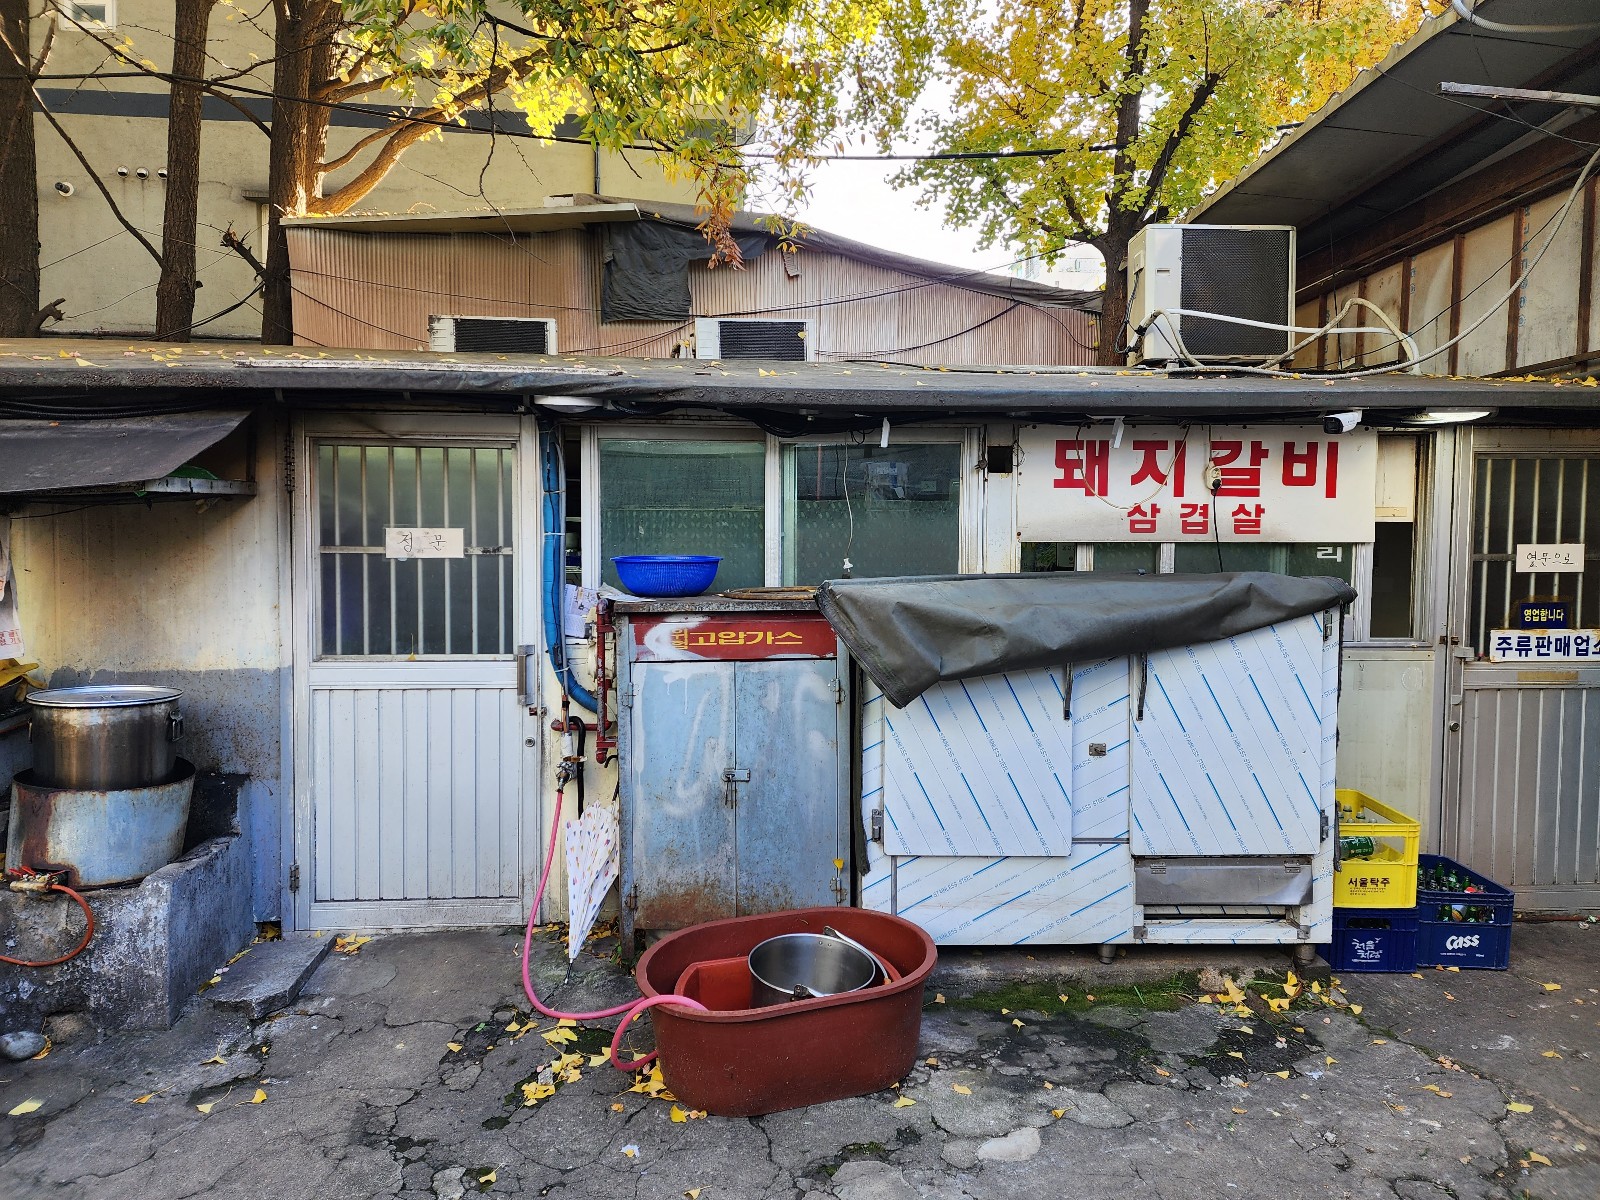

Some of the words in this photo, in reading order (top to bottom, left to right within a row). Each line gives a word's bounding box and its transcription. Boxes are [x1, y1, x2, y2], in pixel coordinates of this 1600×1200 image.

[1053, 439, 1339, 499] 돼지갈비
[1127, 503, 1265, 535] 삼겹살
[1317, 546, 1342, 562] 리
[1524, 608, 1564, 622] 영업합니다
[689, 631, 802, 646] 고압가스
[1348, 877, 1390, 887] 서울탁주
